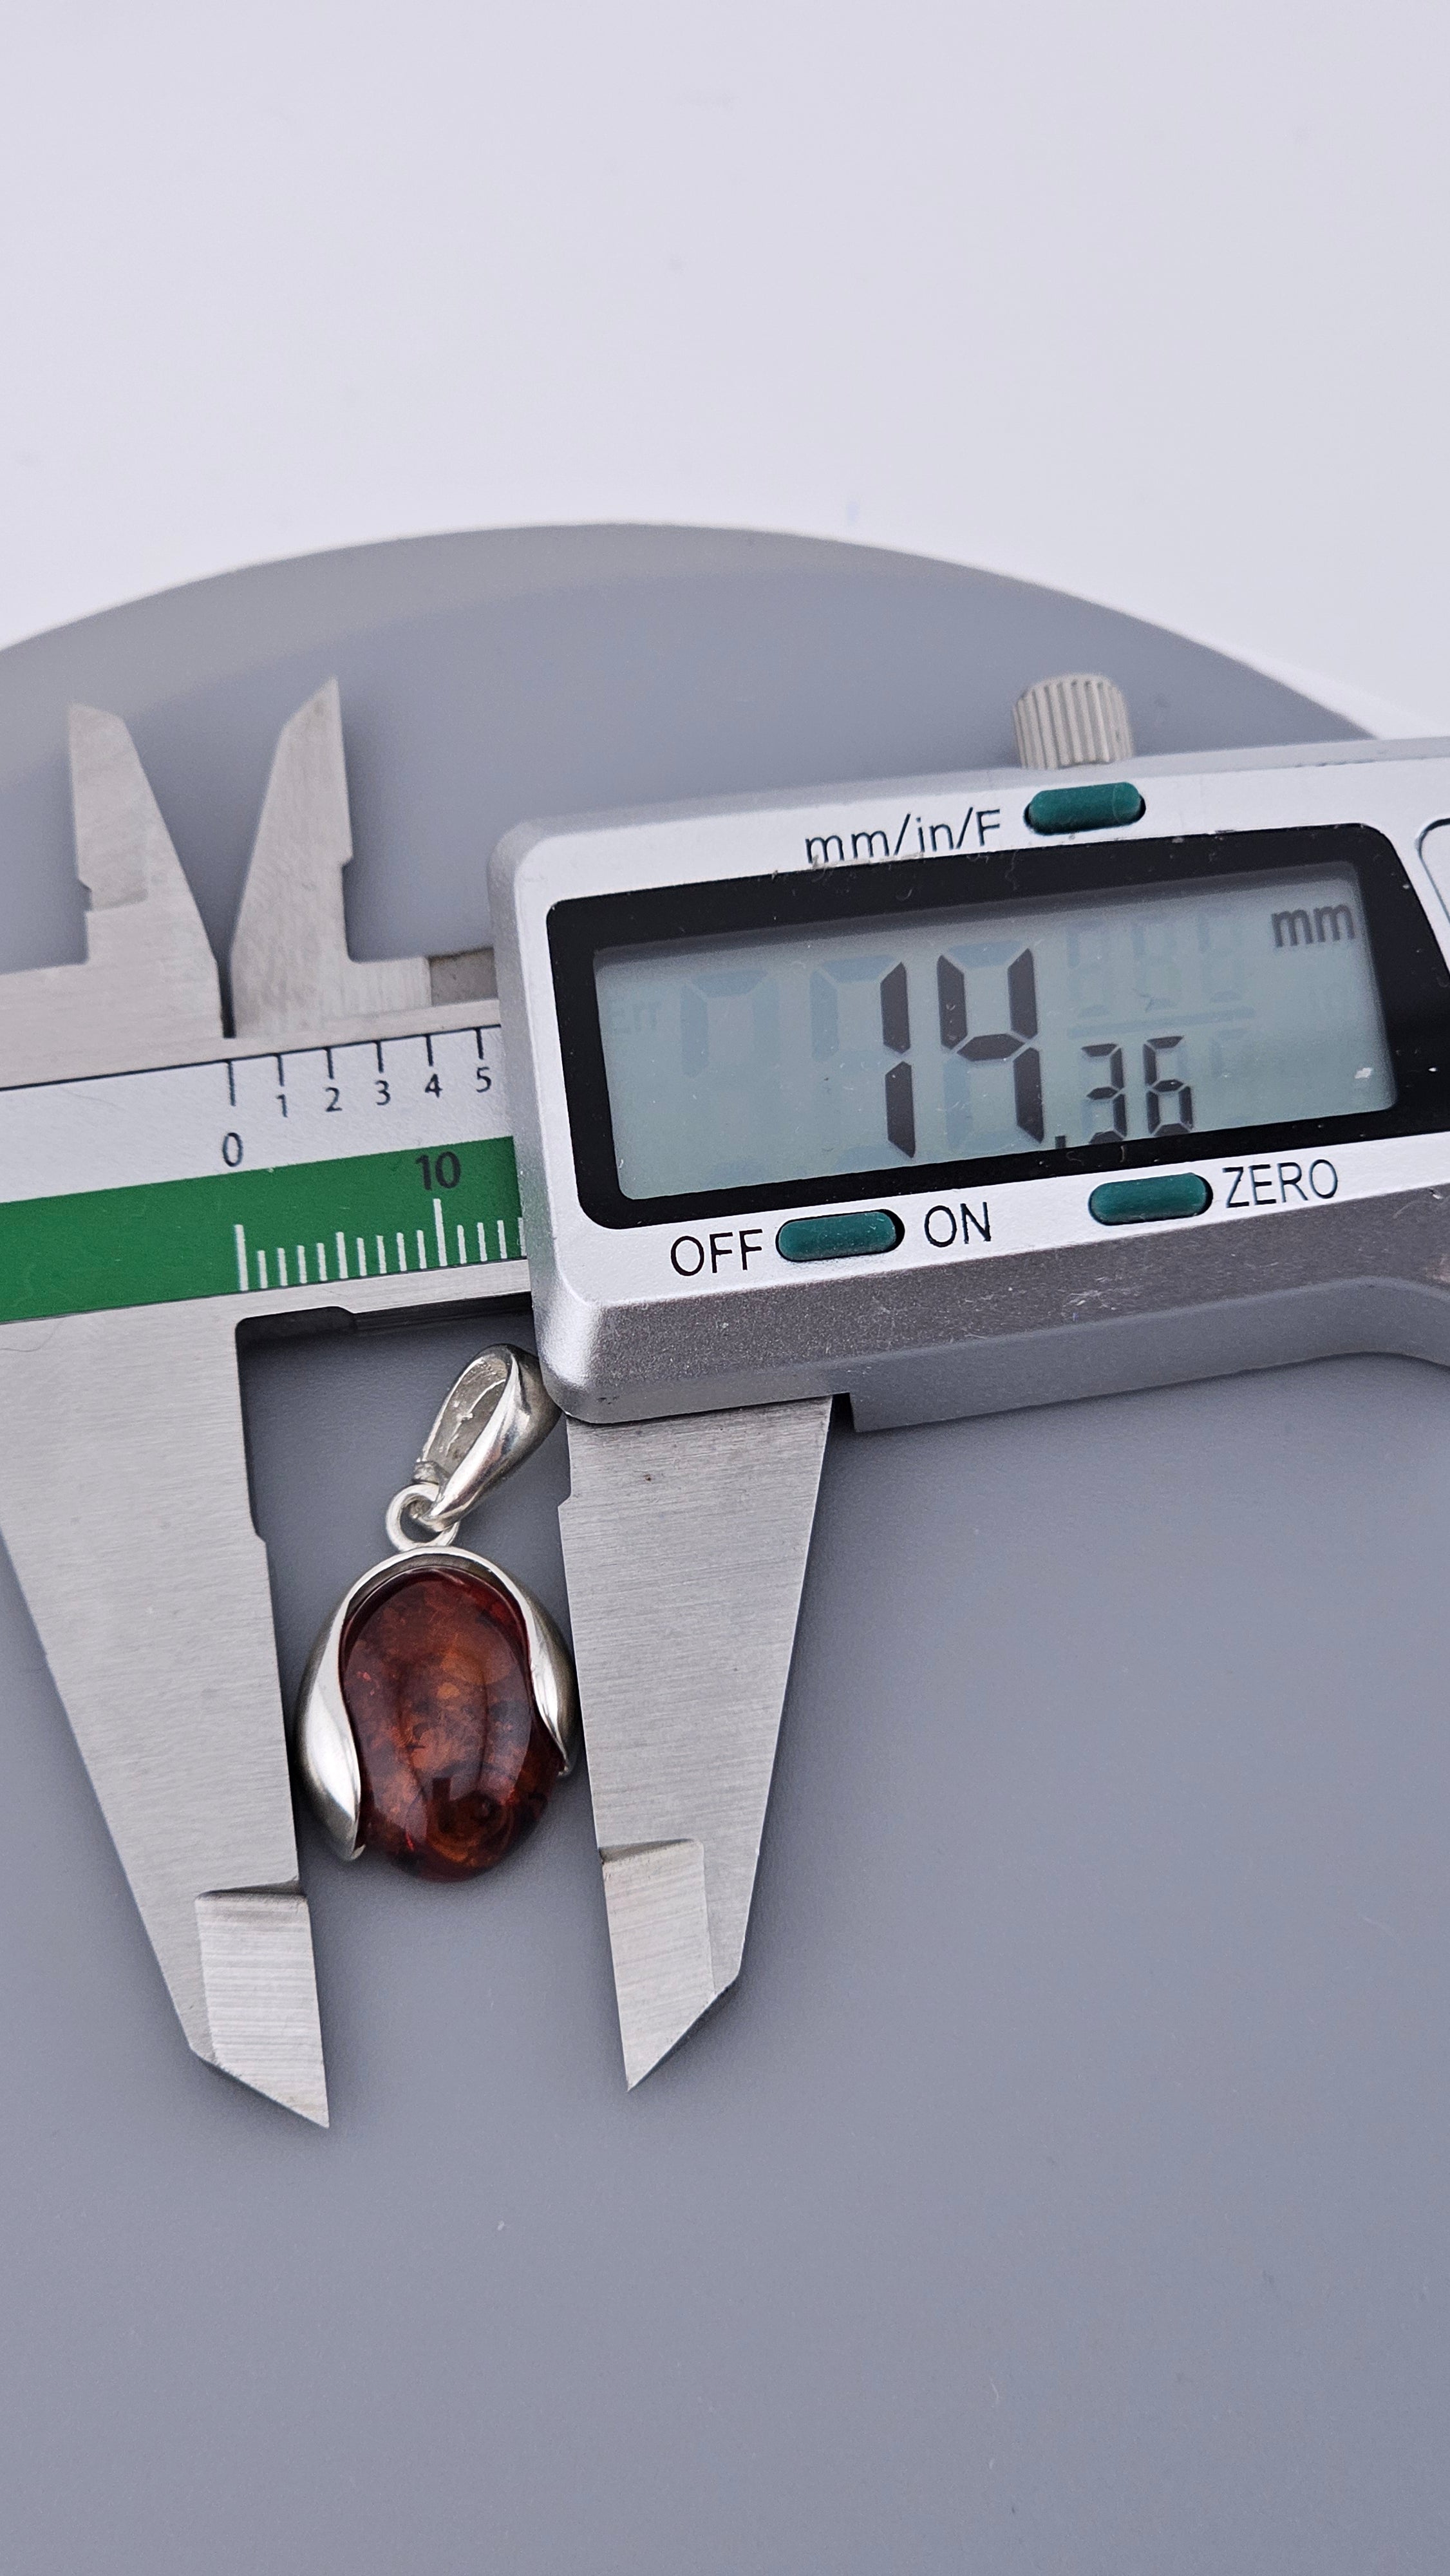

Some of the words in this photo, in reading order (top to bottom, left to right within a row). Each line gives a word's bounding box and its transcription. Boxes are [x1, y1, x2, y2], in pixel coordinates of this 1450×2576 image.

[804, 806, 1001, 864] mm/in/F
[1270, 902, 1355, 948] mm
[880, 947, 1194, 1158] 14.36
[276, 1094, 288, 1117] 1
[325, 1086, 343, 1113] 2
[375, 1079, 391, 1106] 3
[424, 1074, 443, 1099] 4
[475, 1066, 492, 1094] 5
[222, 1132, 244, 1168] 0
[415, 1150, 462, 1191] 10
[670, 1228, 764, 1277] OFF
[924, 1201, 992, 1248] ON
[1223, 1159, 1339, 1209] ZERO
